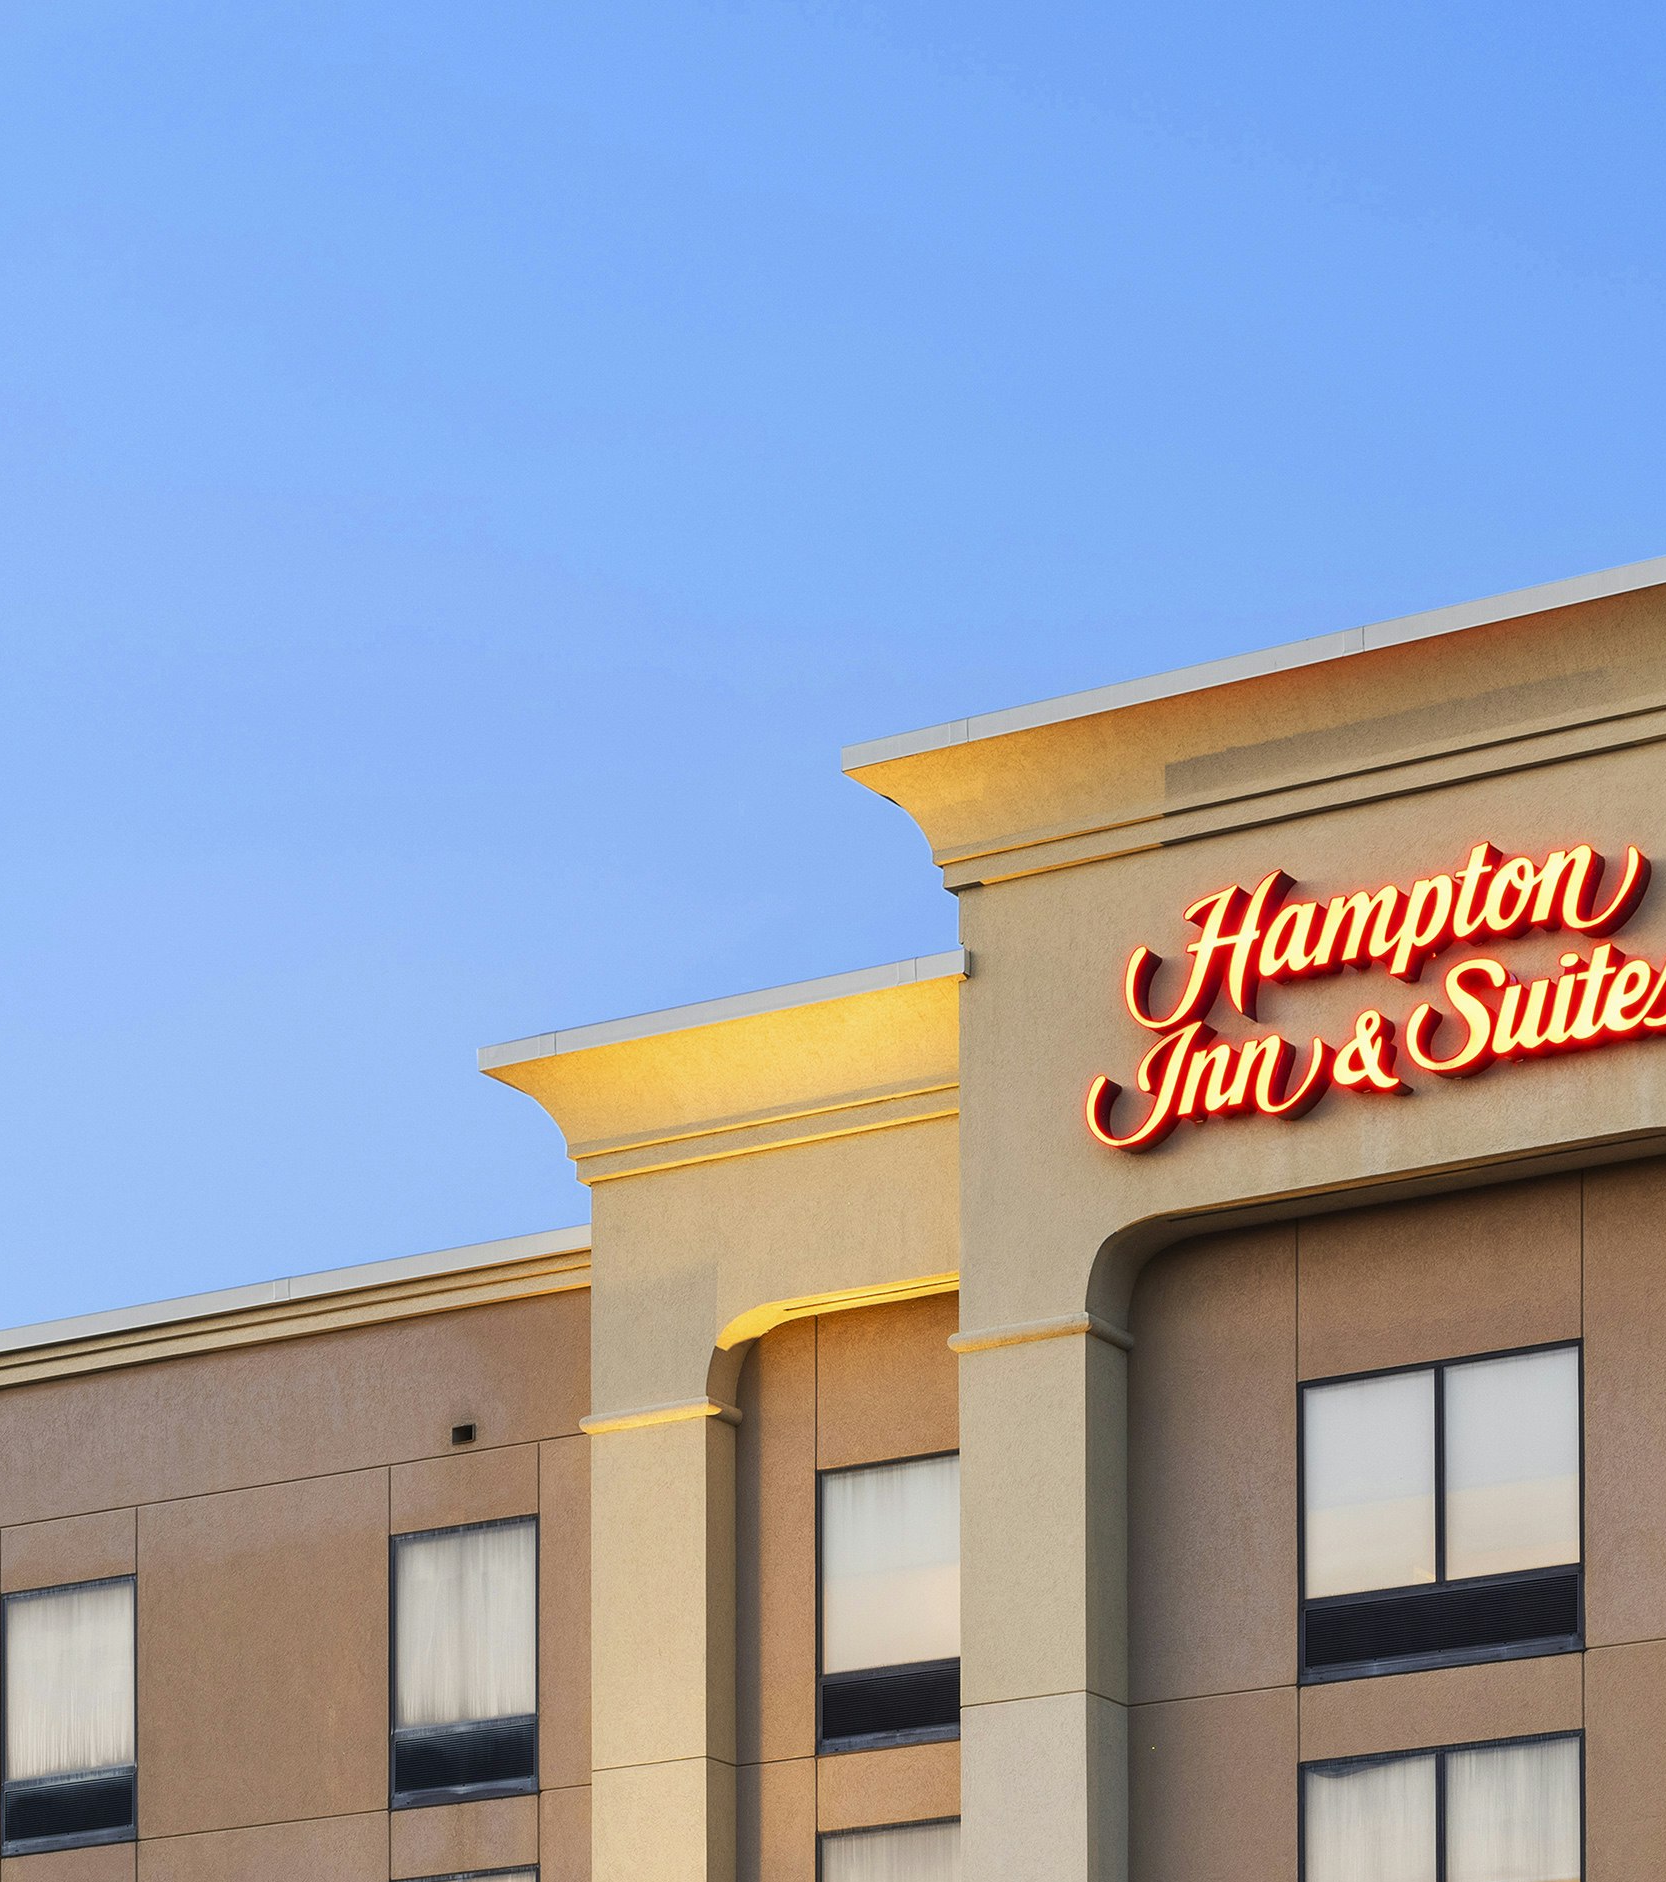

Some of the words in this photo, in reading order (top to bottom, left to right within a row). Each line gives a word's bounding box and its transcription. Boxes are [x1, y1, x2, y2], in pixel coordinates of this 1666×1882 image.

[1124, 840, 1651, 1030] Hampton
[1085, 1021, 1333, 1152] Inn
[1332, 1009, 1413, 1096] &
